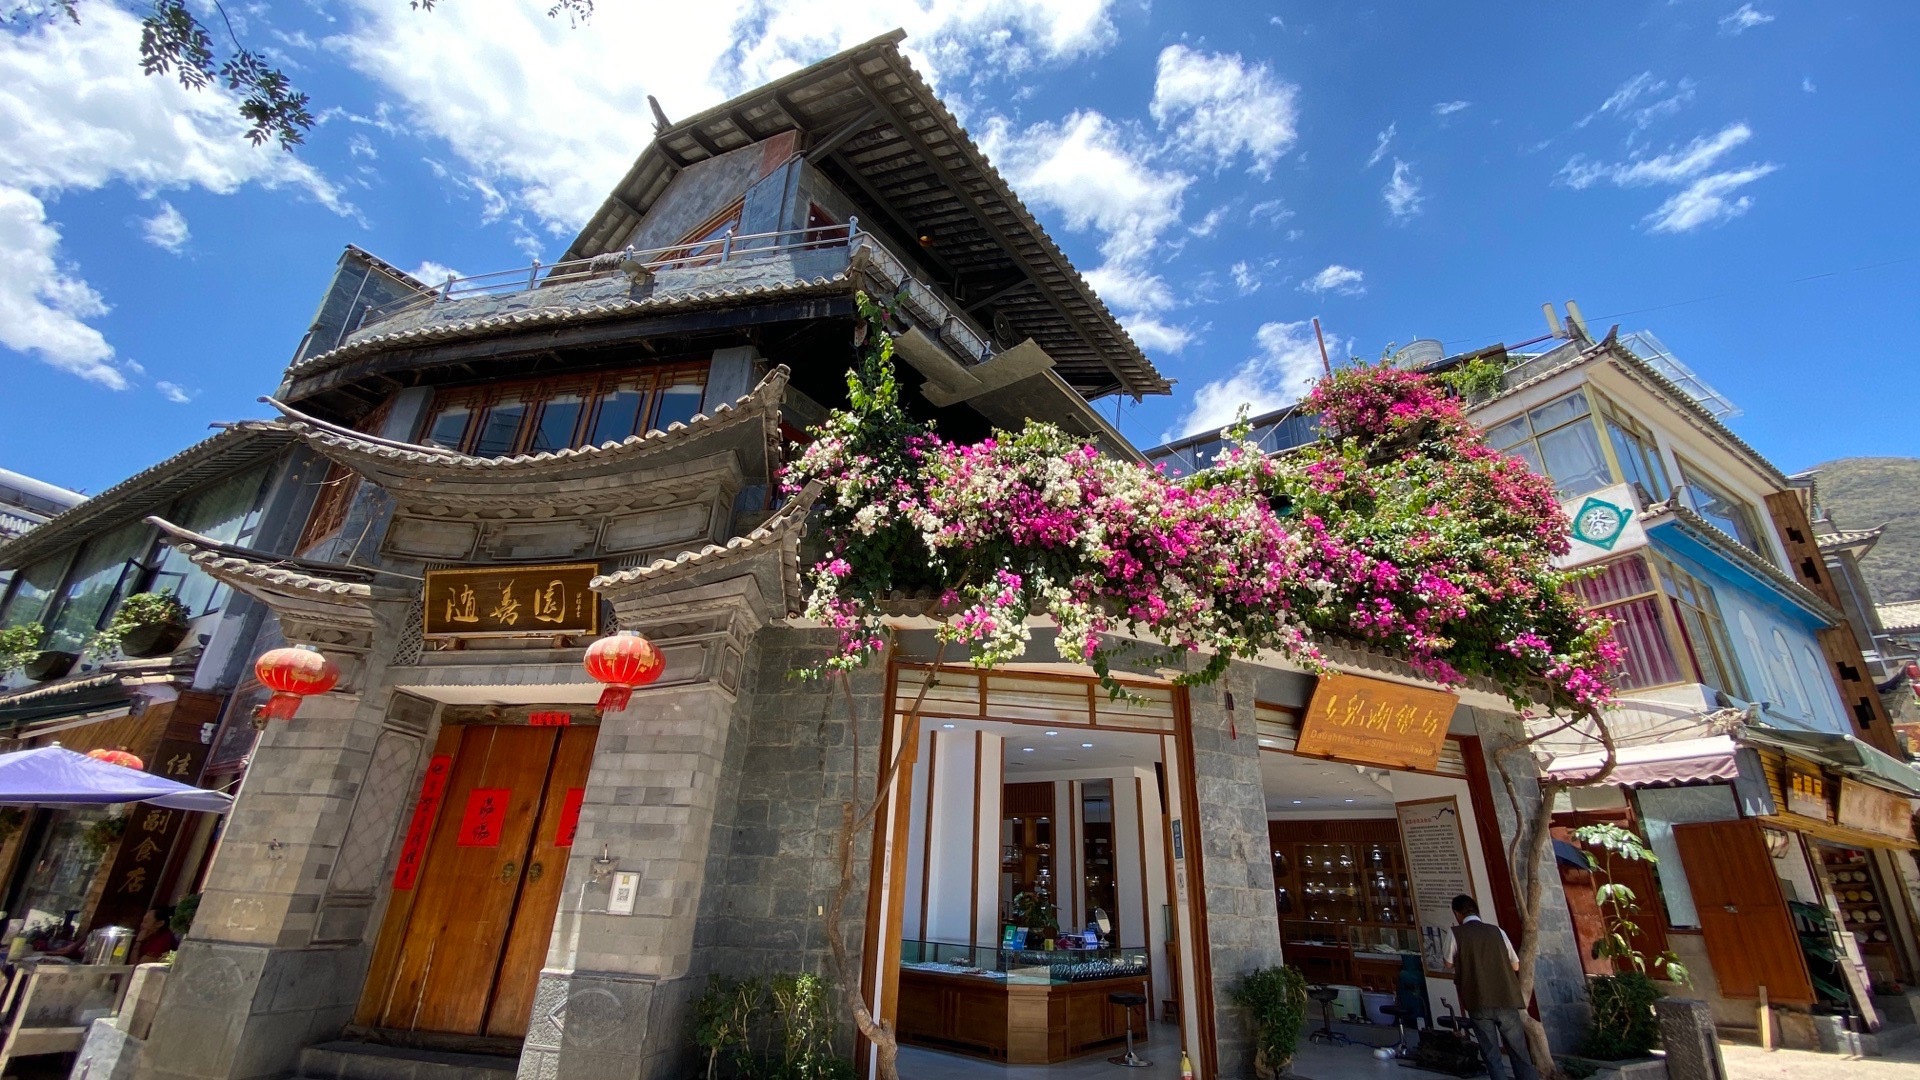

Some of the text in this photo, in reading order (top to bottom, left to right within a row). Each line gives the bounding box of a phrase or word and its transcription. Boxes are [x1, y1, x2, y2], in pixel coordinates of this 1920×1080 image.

[1587, 509, 1617, 535] 茶
[1310, 729, 1433, 757] Daughter Lake Silver Workshop
